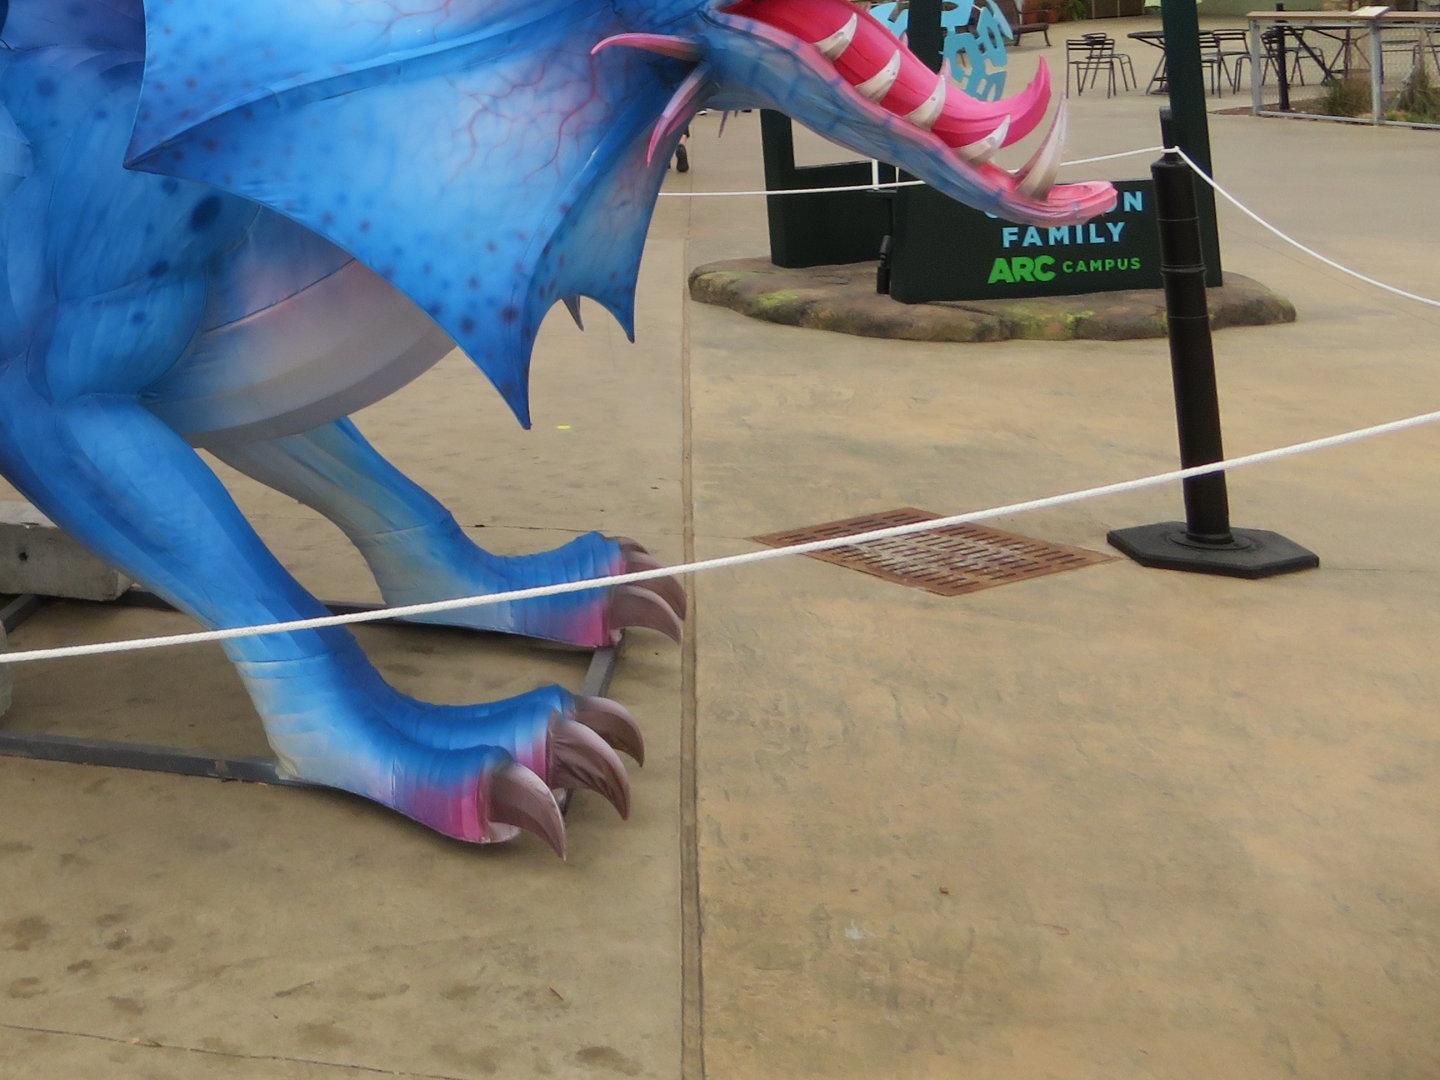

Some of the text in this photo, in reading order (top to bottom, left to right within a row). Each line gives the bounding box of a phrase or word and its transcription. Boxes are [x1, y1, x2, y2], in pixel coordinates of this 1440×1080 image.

[1002, 221, 1125, 248] FAMILY
[987, 255, 1141, 284] ARC CAMPUS
